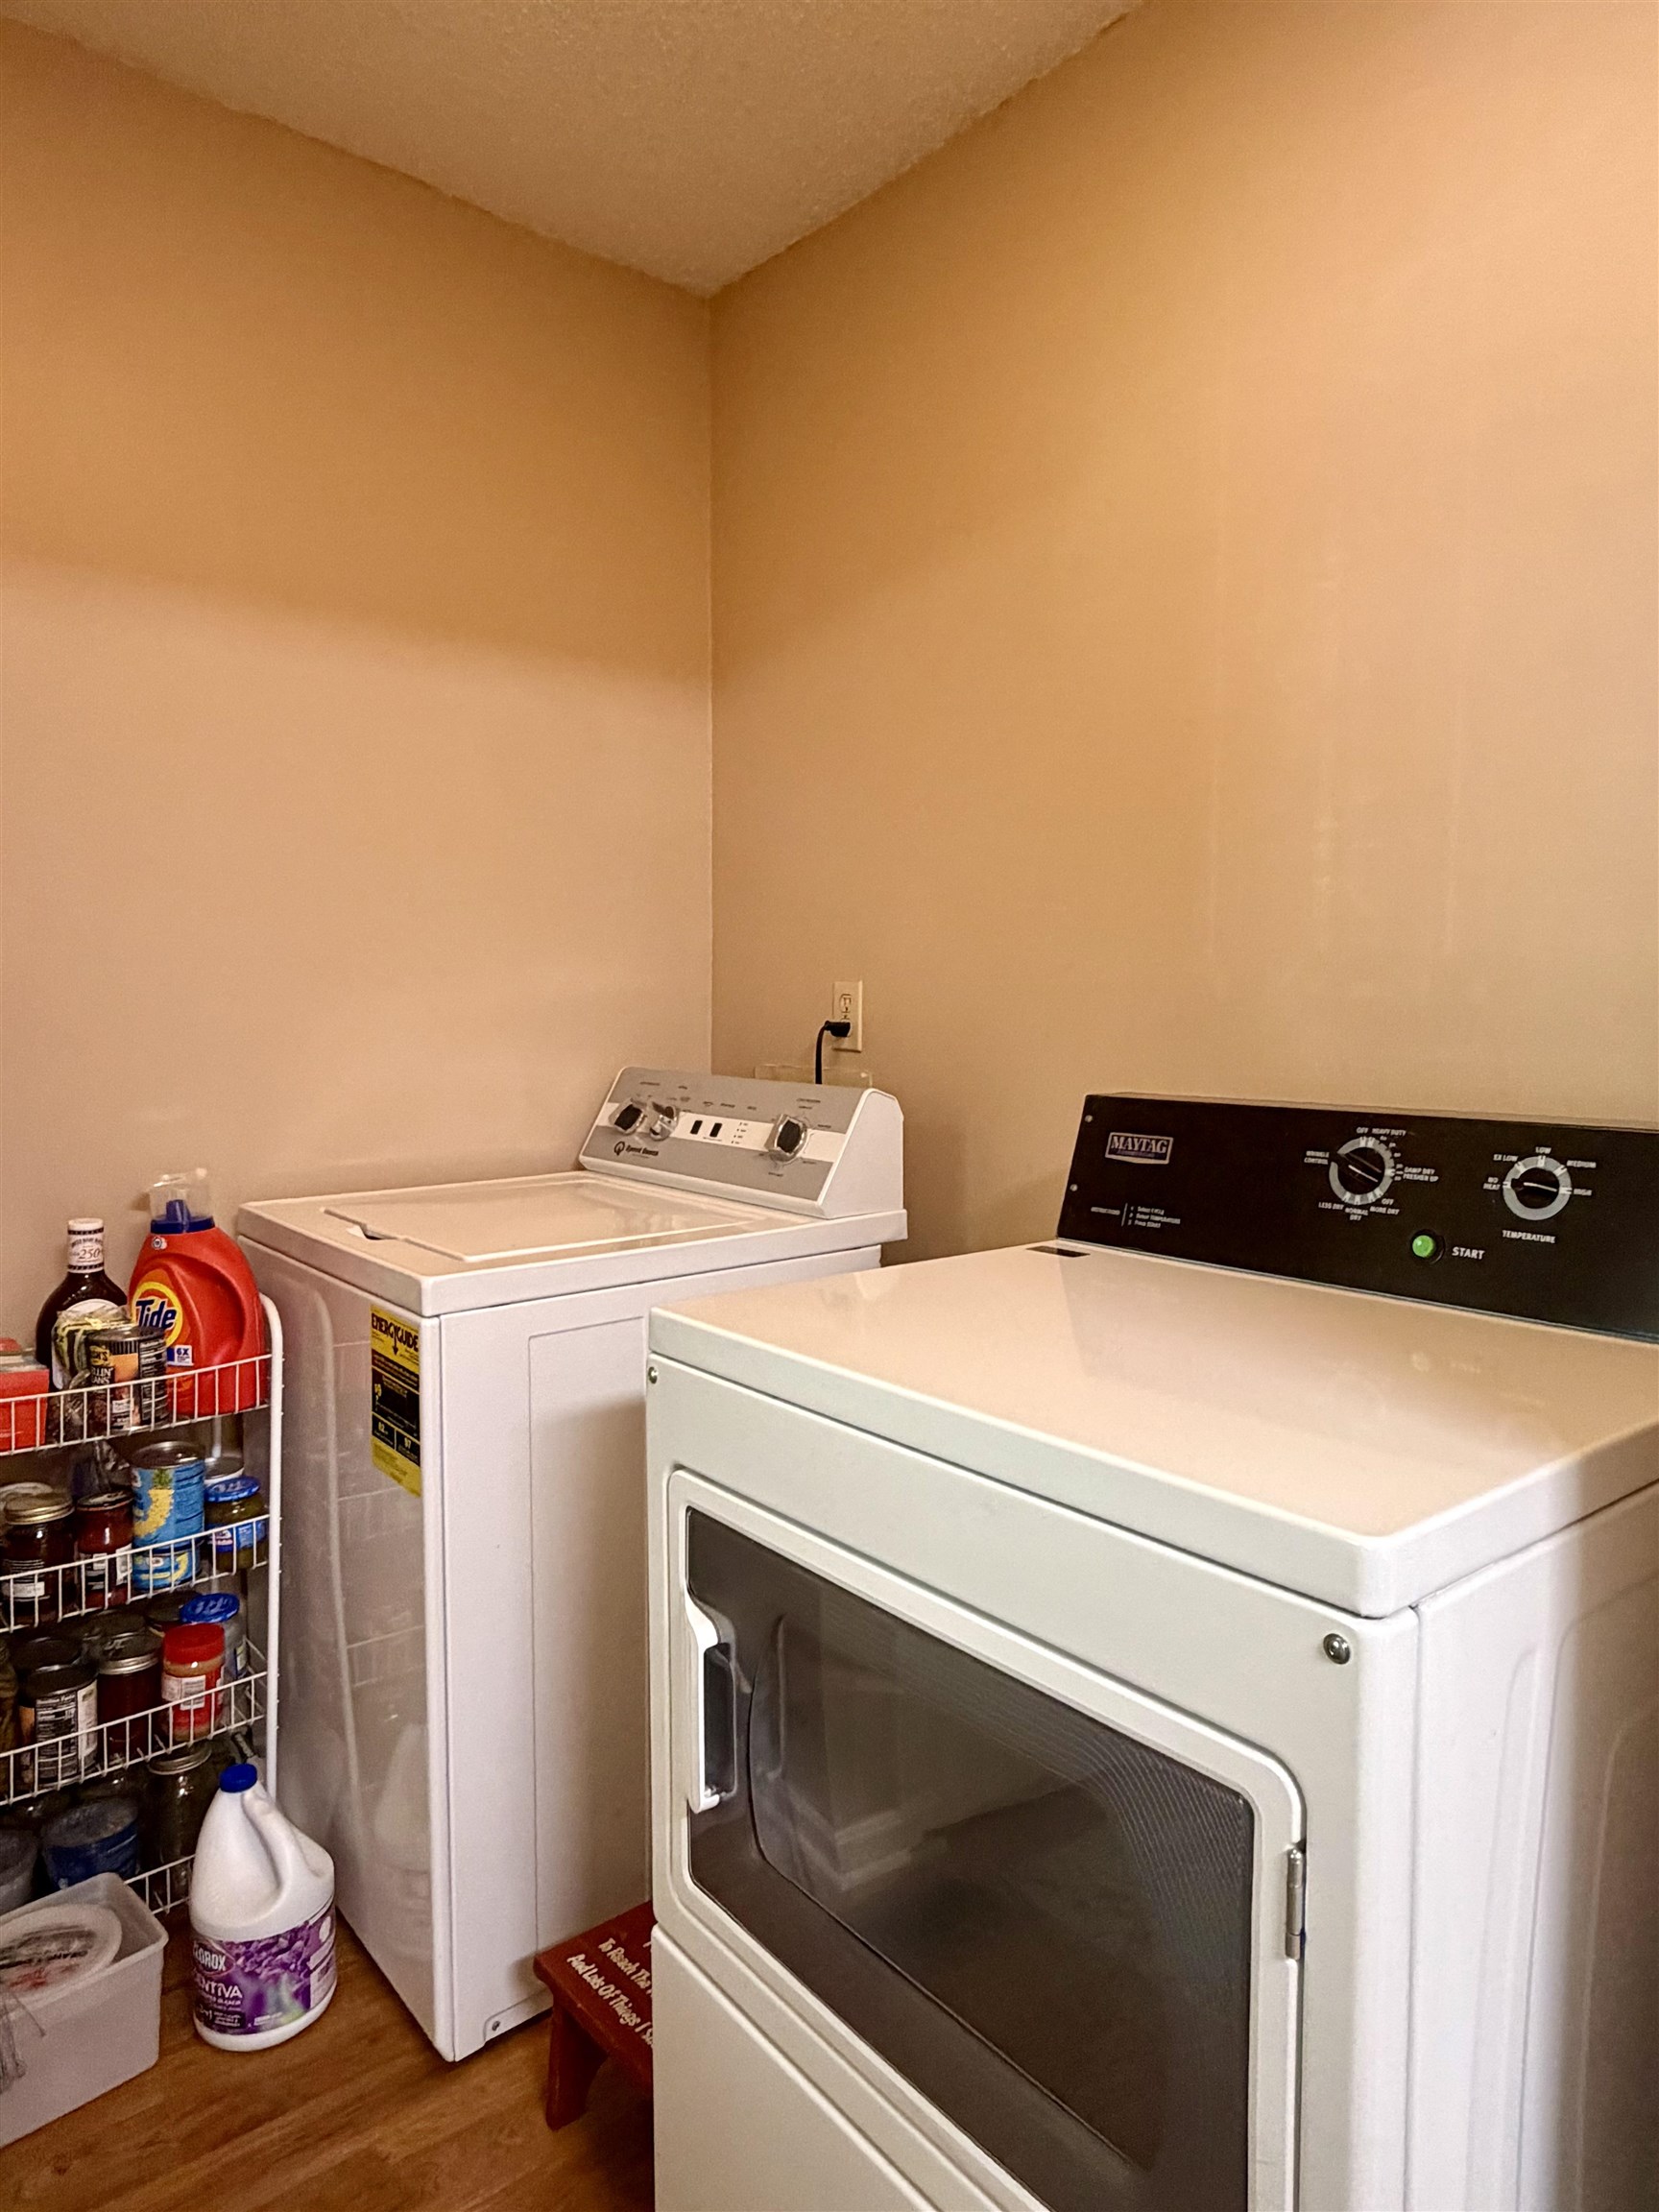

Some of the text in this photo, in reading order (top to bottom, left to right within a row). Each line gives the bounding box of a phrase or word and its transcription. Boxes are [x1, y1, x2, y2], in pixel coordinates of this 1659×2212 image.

[1111, 1136, 1168, 1154] MAYTAG
[1535, 1146, 1551, 1155] LOW
[1503, 1230, 1555, 1243] TEMPERATURE
[1452, 1246, 1485, 1261] START
[135, 1299, 178, 1330] Tide
[566, 1954, 595, 1975] And
[598, 1937, 615, 1953] To
[607, 1947, 640, 1976] Reach
[582, 1968, 605, 1989] Lots
[598, 1984, 622, 2000] Of
[609, 1994, 641, 2027] Things
